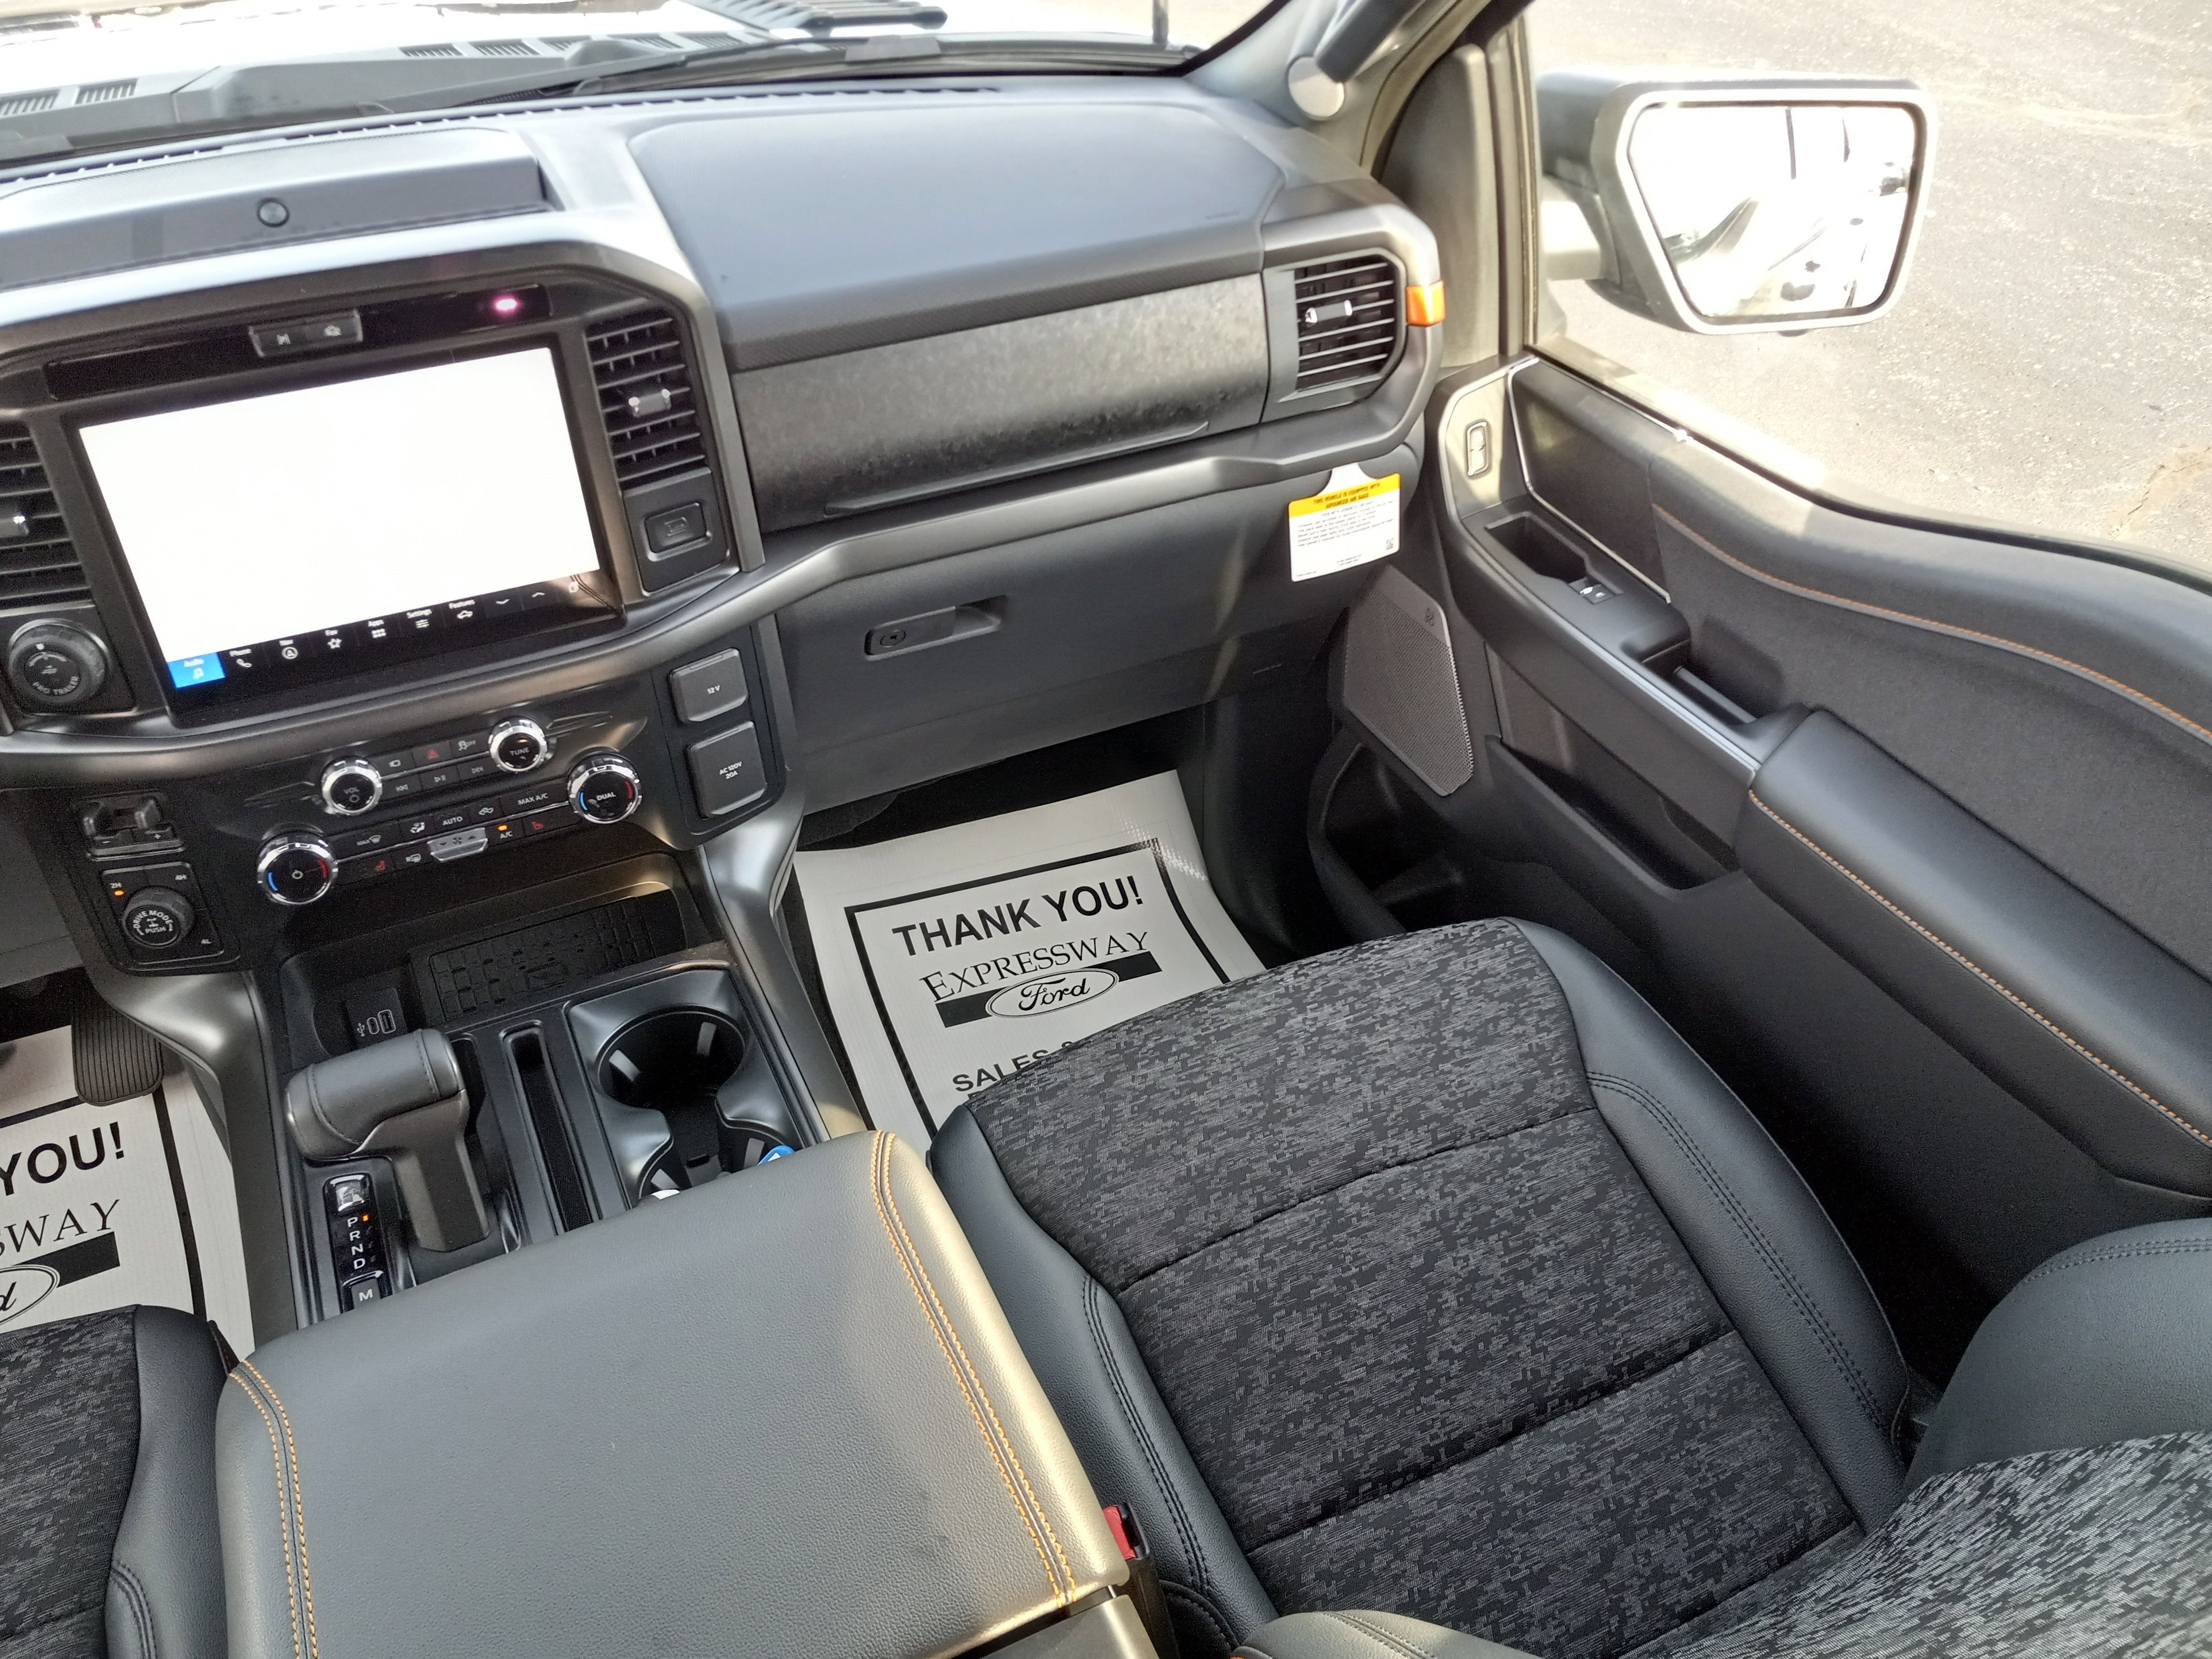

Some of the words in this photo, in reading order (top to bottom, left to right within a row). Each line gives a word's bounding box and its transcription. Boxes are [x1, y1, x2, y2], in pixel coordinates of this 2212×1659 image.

[509, 747, 530, 756] TUNE
[517, 797, 534, 806] MAX
[535, 793, 549, 802] A/C
[596, 791, 617, 801] DUAL
[443, 816, 463, 826] AUTO
[500, 831, 513, 839] A/C
[133, 911, 149, 929] DRIVE
[149, 910, 174, 925] MODE
[892, 899, 1042, 956] THANK
[1042, 876, 1144, 922] YOU!
[145, 926, 167, 934] PUSH
[919, 931, 1148, 1002] EXPRESSWAY
[1018, 978, 1091, 1011] Ford
[0, 1121, 125, 1196] YOU!
[347, 1216, 358, 1227] P
[0, 1199, 120, 1257] WAY
[349, 1230, 361, 1241] R
[351, 1244, 363, 1255] N
[353, 1258, 365, 1270] D
[359, 1289, 373, 1302] M
